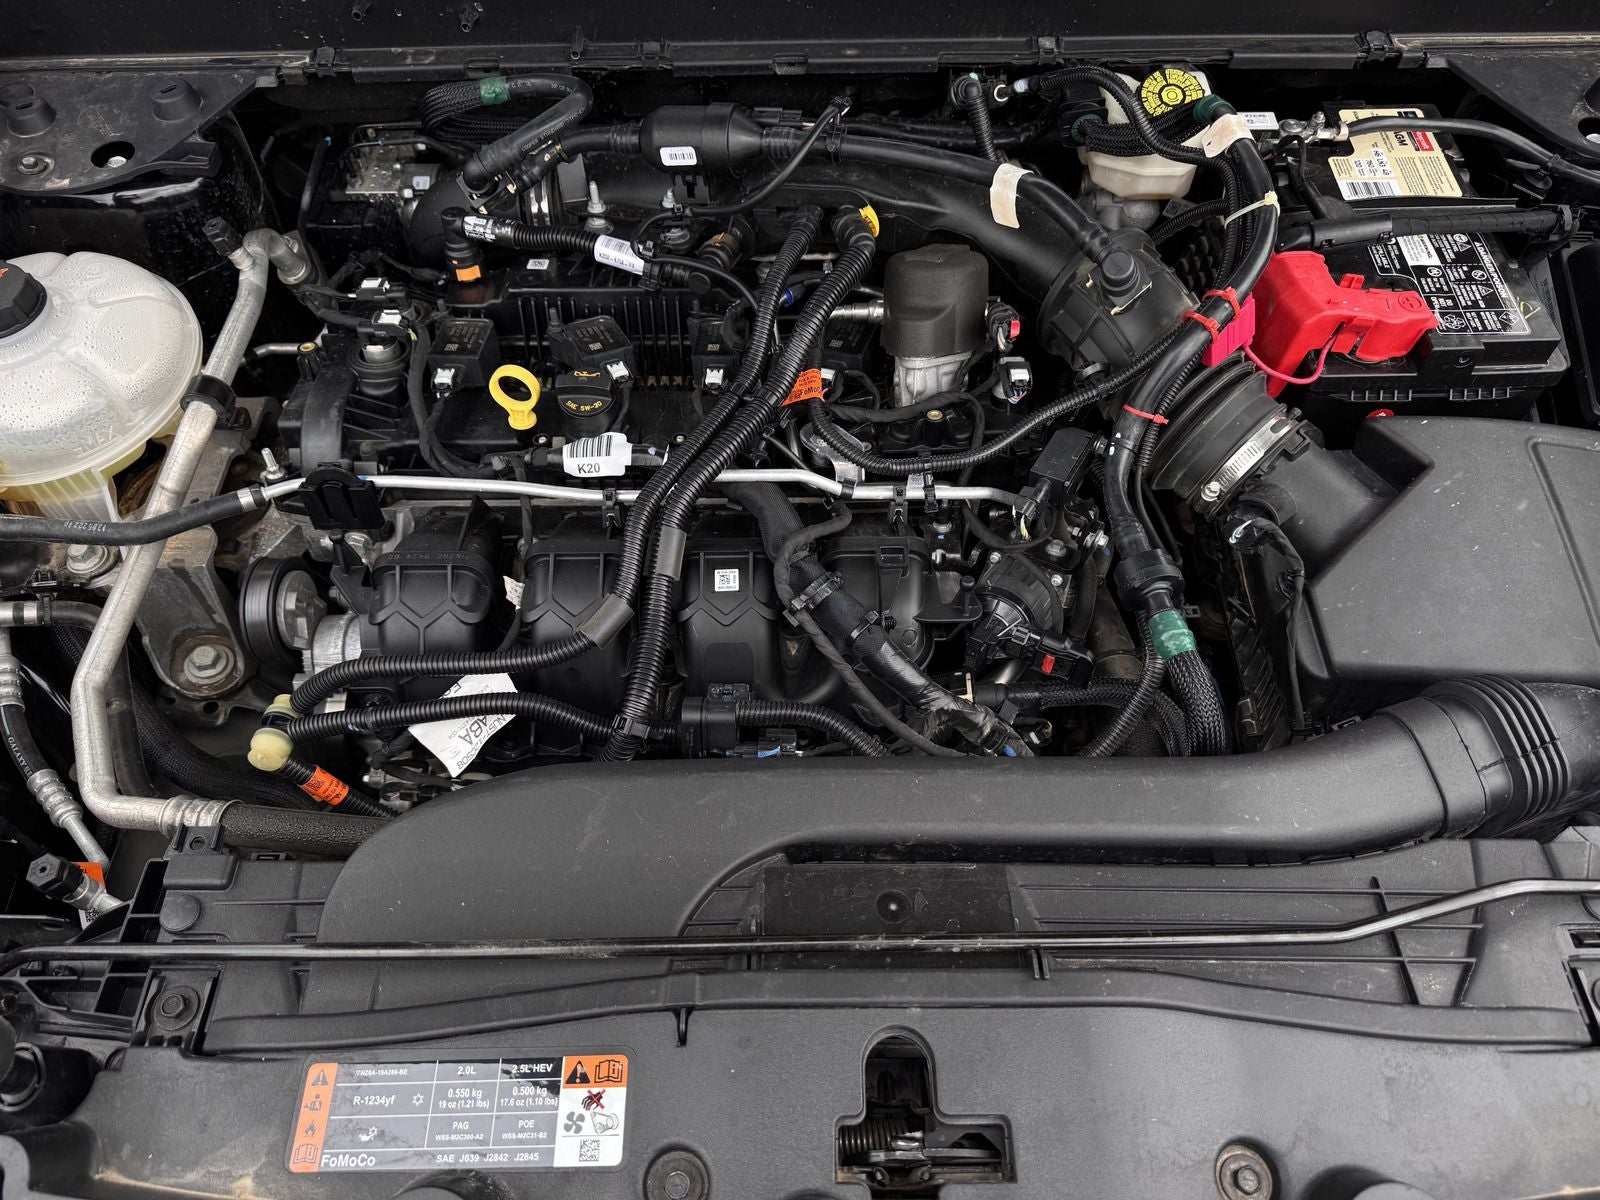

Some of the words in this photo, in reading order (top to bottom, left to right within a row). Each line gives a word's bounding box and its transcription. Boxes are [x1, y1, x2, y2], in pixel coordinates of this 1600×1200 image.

[566, 401, 578, 409] SAE
[580, 401, 602, 411] 5W-30
[578, 463, 600, 474] K20
[457, 715, 486, 745] ABA
[8, 737, 27, 766] GALAXY
[458, 1066, 476, 1074] 2.0L
[512, 1065, 530, 1073] 2.5L
[532, 1064, 553, 1072] HEV
[448, 1089, 470, 1097] 0.550
[472, 1089, 482, 1099] kg
[513, 1087, 534, 1095] 0.500
[537, 1087, 547, 1097] kg
[353, 1095, 395, 1107] R-1234yf
[458, 1101, 474, 1109] (1.21
[476, 1100, 489, 1109] lbs)
[526, 1098, 542, 1107] (1.10
[544, 1097, 557, 1106] lbs)
[453, 1122, 469, 1130] PAG
[519, 1120, 534, 1128] POE
[321, 1155, 376, 1167] FoMoCo
[436, 1154, 455, 1163] SAE
[459, 1154, 479, 1162] J639
[484, 1153, 508, 1162] J2842
[514, 1153, 539, 1161] J2845
